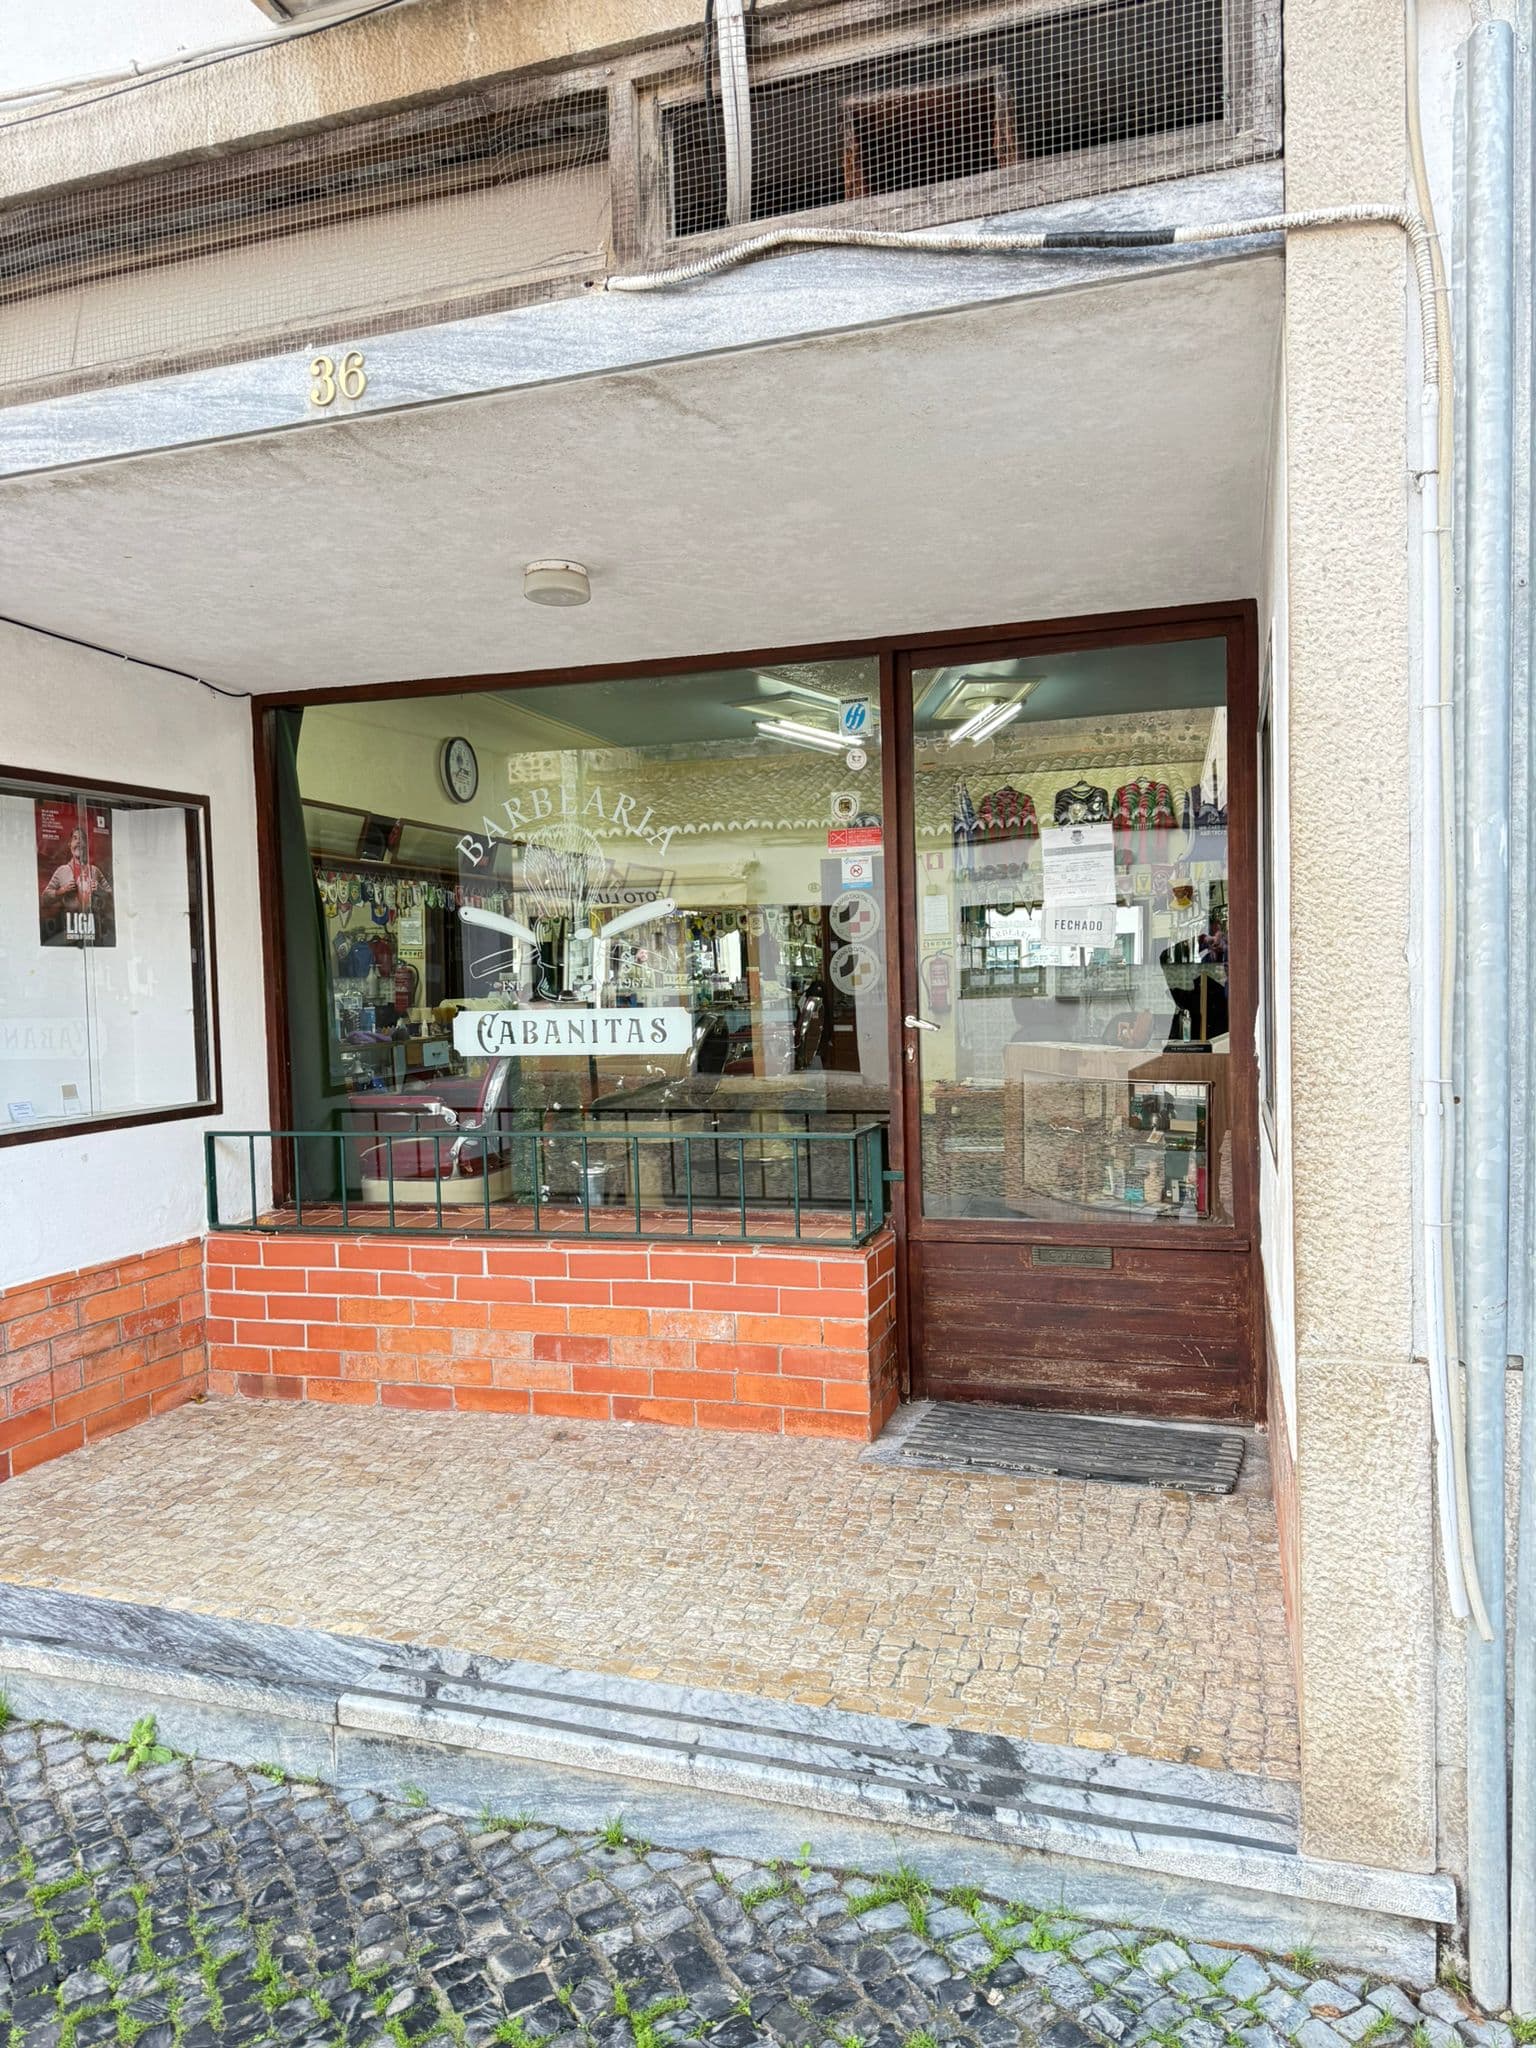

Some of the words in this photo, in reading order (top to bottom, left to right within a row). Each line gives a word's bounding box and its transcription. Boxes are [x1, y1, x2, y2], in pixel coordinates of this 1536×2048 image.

[310, 350, 367, 406] 36
[456, 784, 674, 867] BARBEARIA
[66, 912, 96, 934] LIGA
[1054, 918, 1104, 931] FECHADO
[502, 980, 524, 991] EST.
[477, 1012, 668, 1054] CABANITAS
